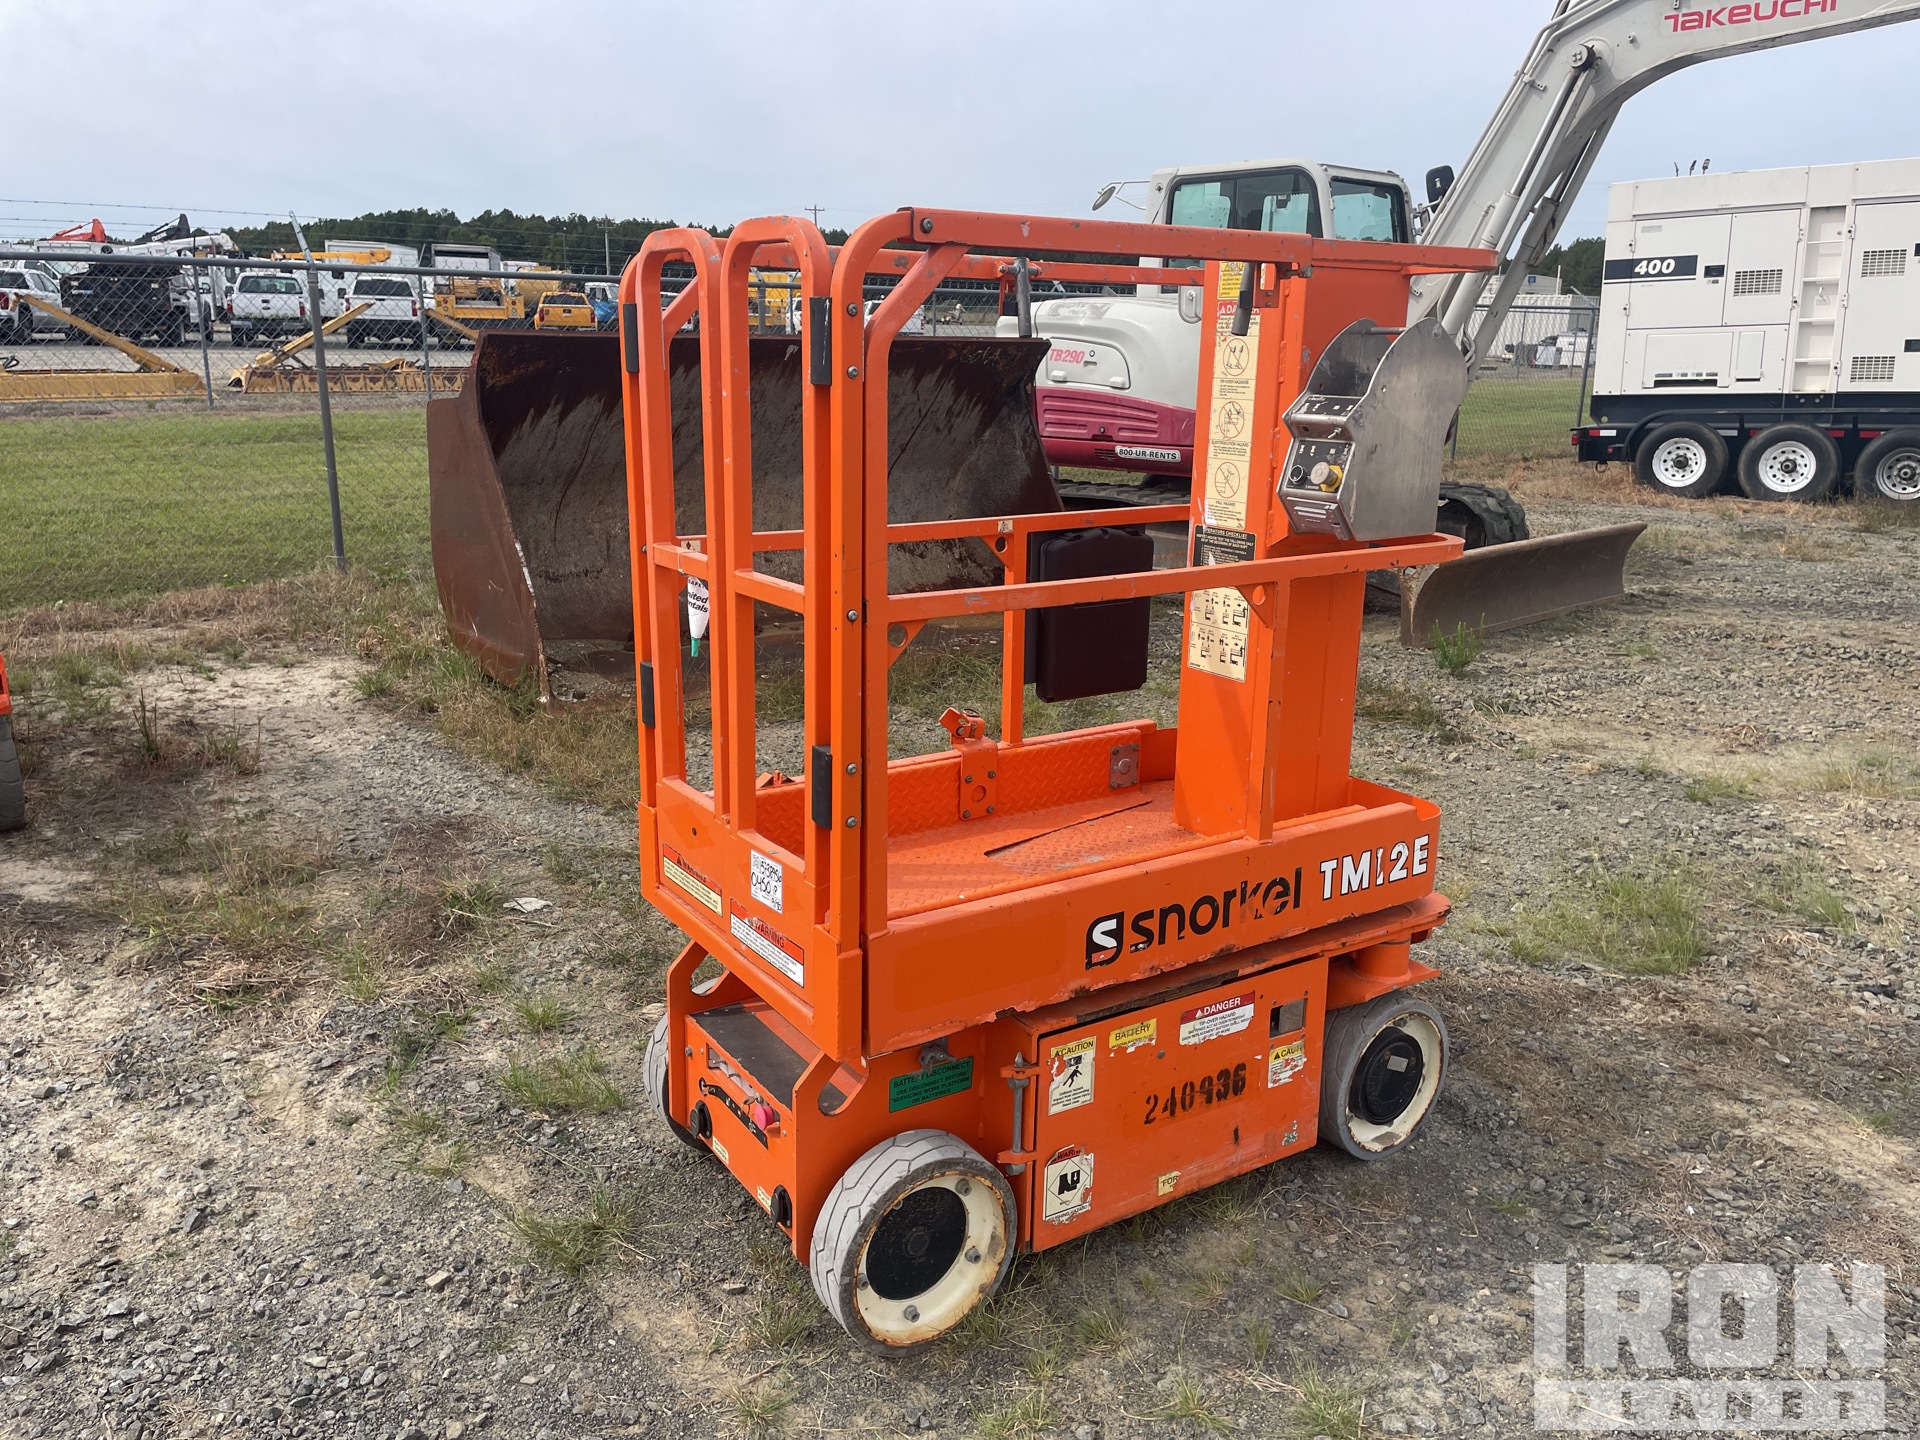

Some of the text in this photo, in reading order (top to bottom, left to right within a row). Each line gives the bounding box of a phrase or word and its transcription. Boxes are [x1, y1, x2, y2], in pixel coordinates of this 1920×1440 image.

[1634, 259, 1675, 275] 400
[1049, 348, 1085, 364] TB290
[1118, 448, 1177, 460] 800-UR-RENTS
[1129, 867, 1302, 954] snorkel
[1204, 997, 1241, 1015] DANGER
[1199, 1012, 1236, 1026] TIP-OVER HAZARD
[1115, 1023, 1151, 1041] BATTERY
[1061, 1040, 1094, 1056] CAUTION
[893, 1076, 970, 1103] SERVICING WORK PLATFORM
[896, 1072, 967, 1096] USE DISCONNECT BEFORE
[922, 1089, 951, 1102] BATTERIES
